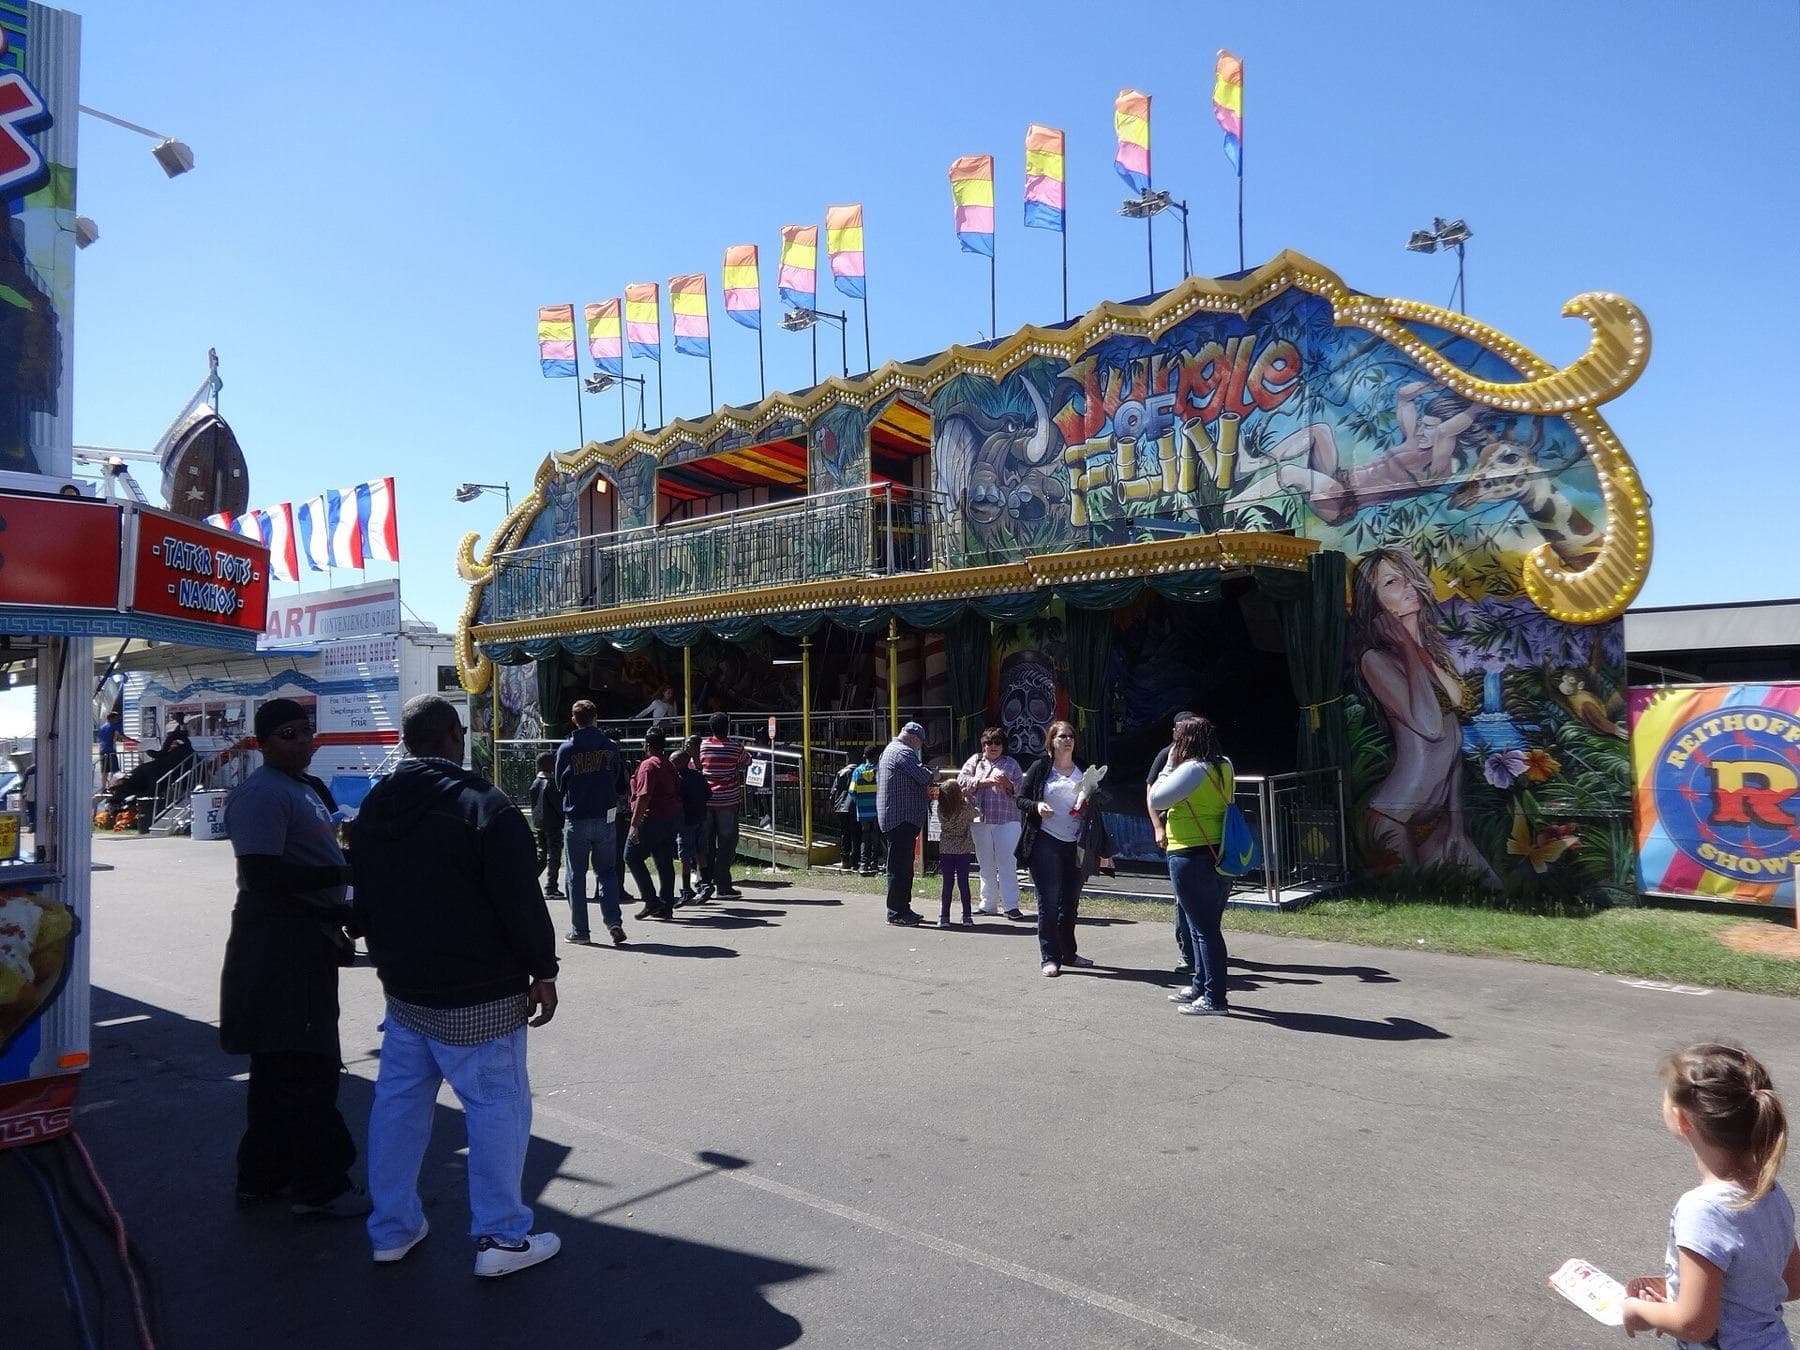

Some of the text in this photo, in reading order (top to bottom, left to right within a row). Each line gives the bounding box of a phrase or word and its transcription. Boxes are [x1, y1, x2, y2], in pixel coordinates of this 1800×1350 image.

[1053, 335, 1303, 447] Jungle
[1114, 393, 1178, 439] OF
[1064, 413, 1241, 528] FUN
[163, 536, 252, 586] TATER TOTS
[179, 578, 236, 615] NACHOS
[320, 608, 396, 635] CONVENIENCE STORE
[1666, 713, 1800, 769] REITHOFF
[1711, 761, 1799, 827] R
